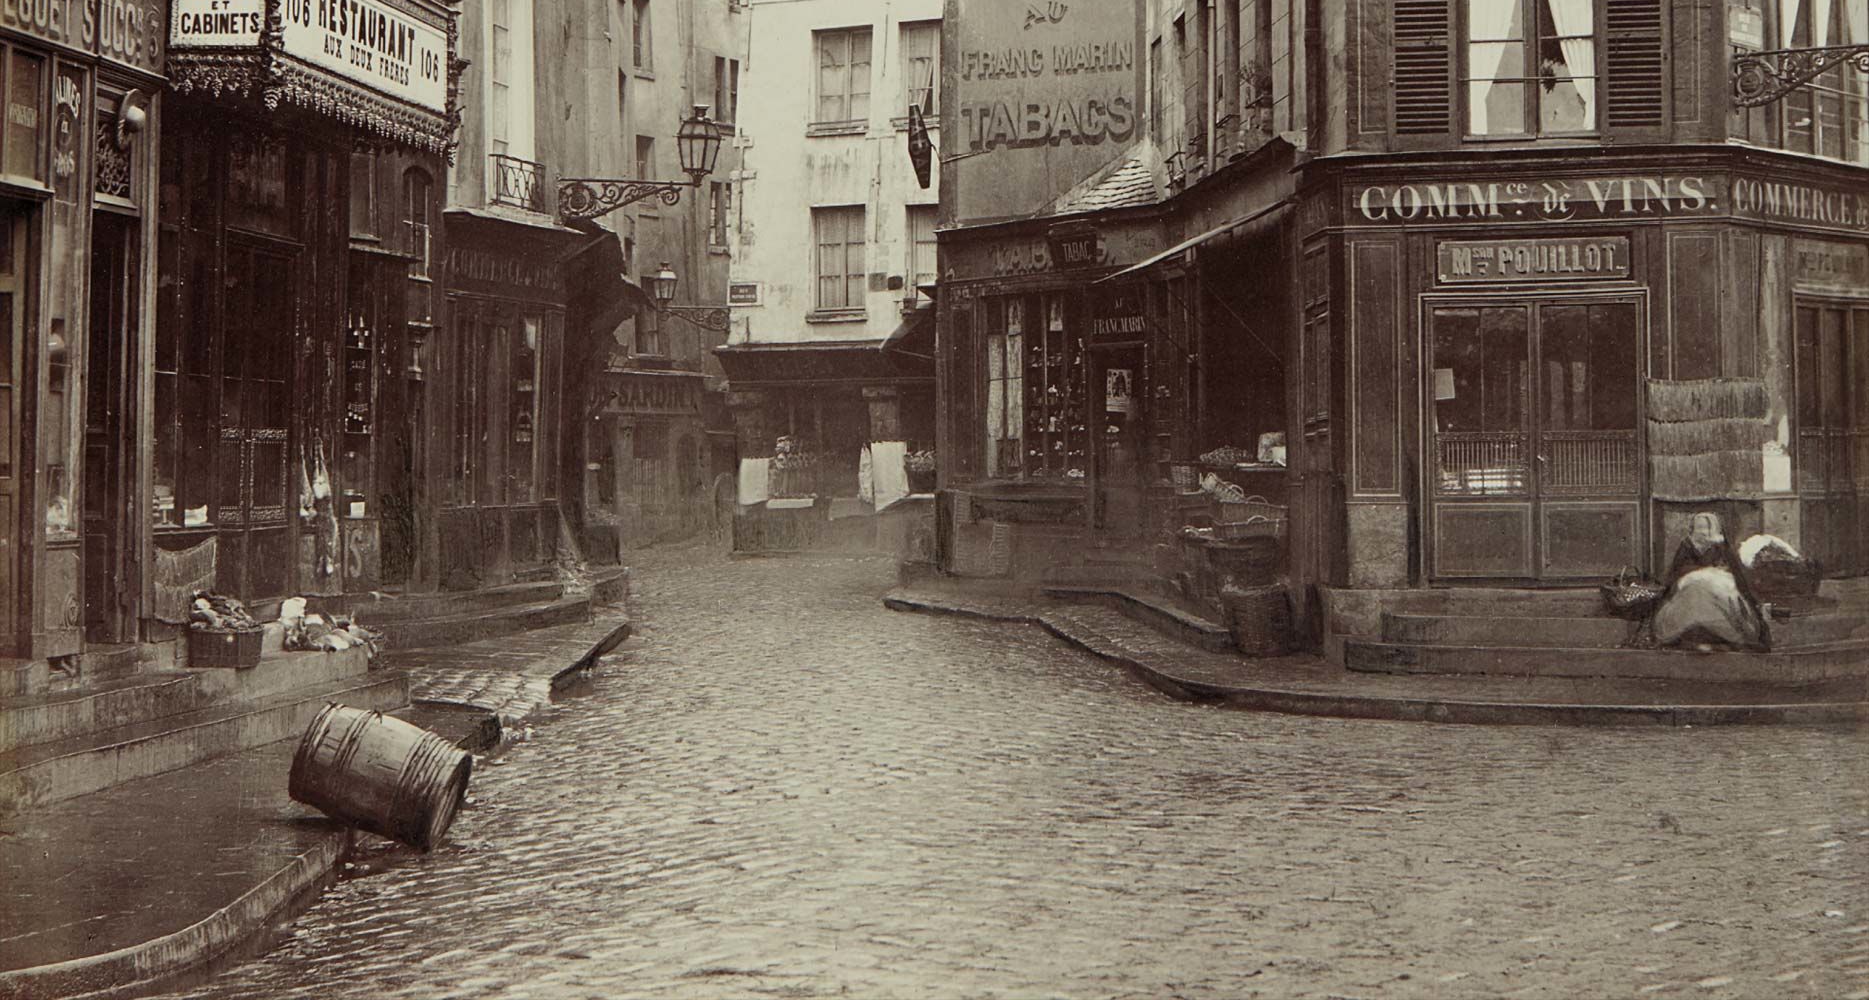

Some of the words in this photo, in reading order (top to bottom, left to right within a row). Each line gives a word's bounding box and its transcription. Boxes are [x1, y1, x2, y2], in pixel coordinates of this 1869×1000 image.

[180, 12, 260, 35] CABINETS
[210, 0, 230, 11] ET
[1023, 0, 1069, 31] AU
[323, 33, 343, 60] AUX
[350, 44, 373, 72] DEUX
[419, 46, 440, 84] 106
[961, 48, 1045, 81] FRANC
[1053, 41, 1133, 76] MARIN
[960, 96, 1136, 151] TABACS
[1735, 176, 1852, 225] COMMERCE
